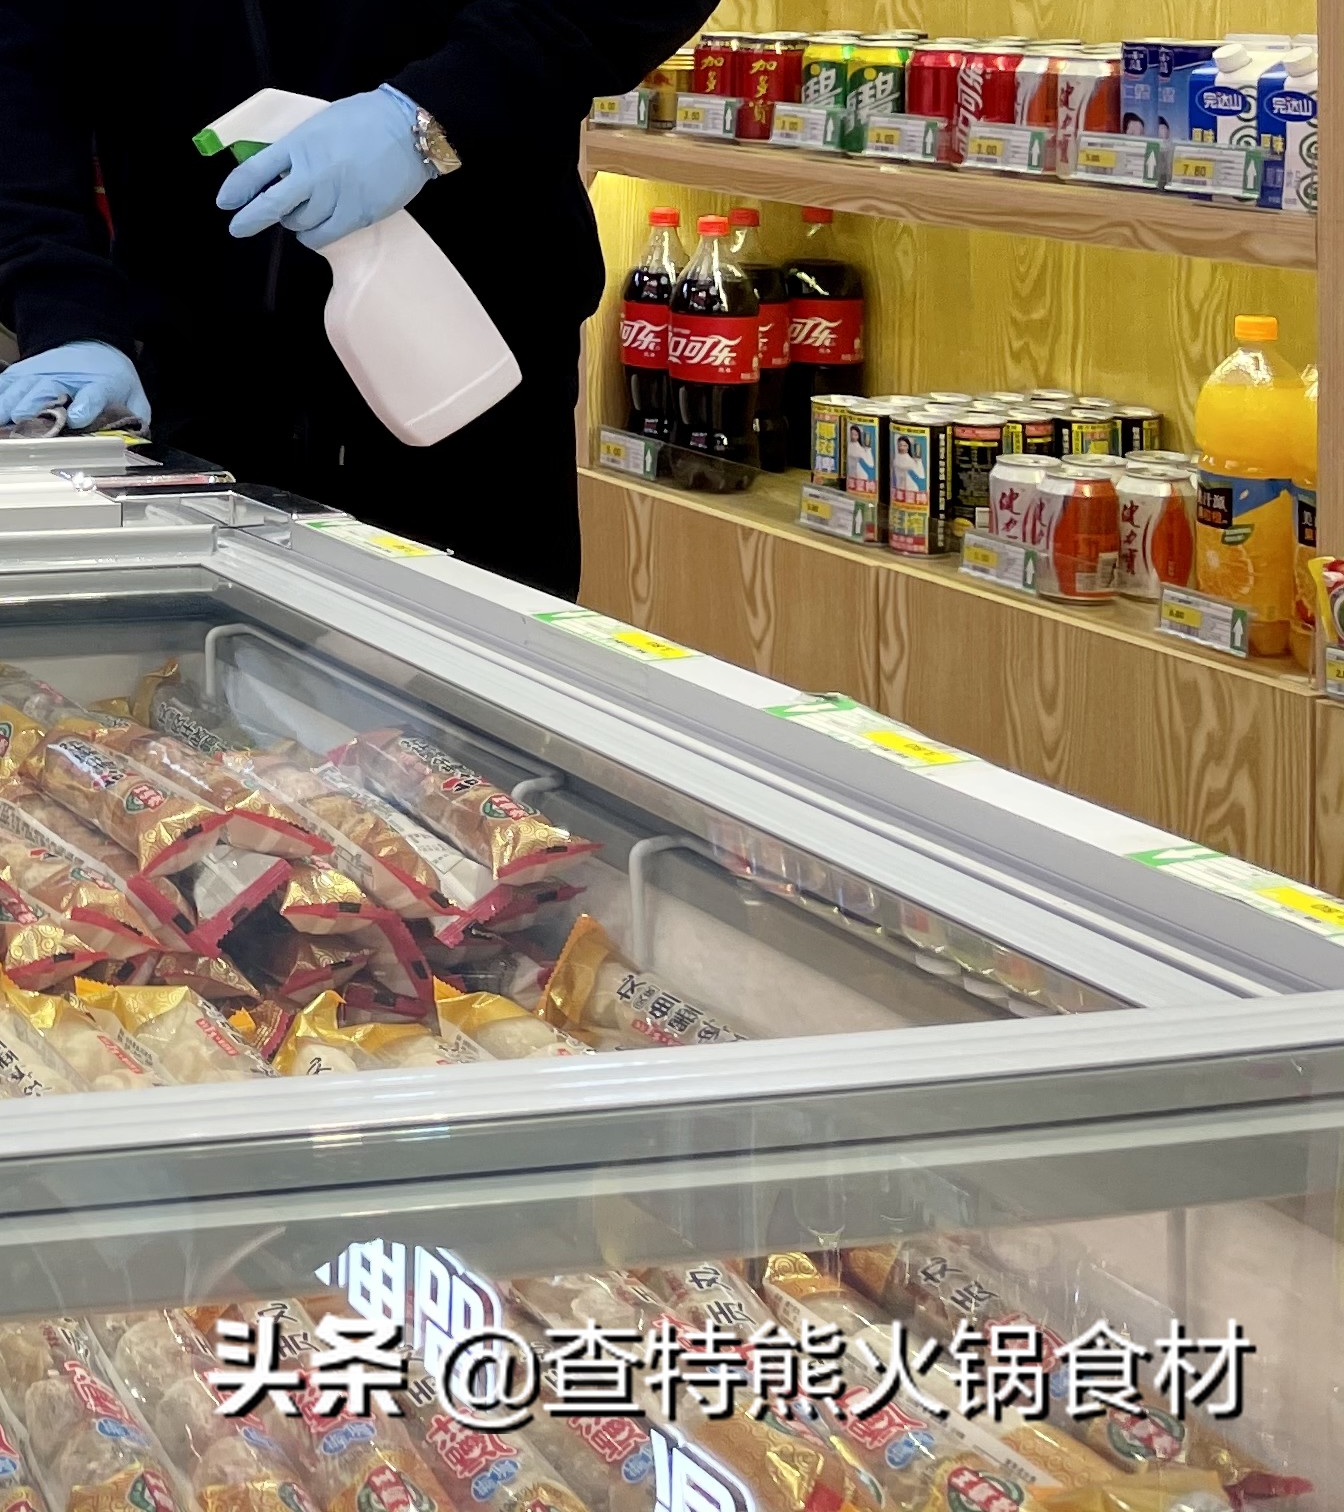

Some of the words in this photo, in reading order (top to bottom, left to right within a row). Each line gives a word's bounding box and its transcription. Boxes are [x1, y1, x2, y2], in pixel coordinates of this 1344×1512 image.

[700, 54, 726, 94] 加多
[1202, 91, 1243, 112] 完达山
[1272, 94, 1313, 116] 完达山
